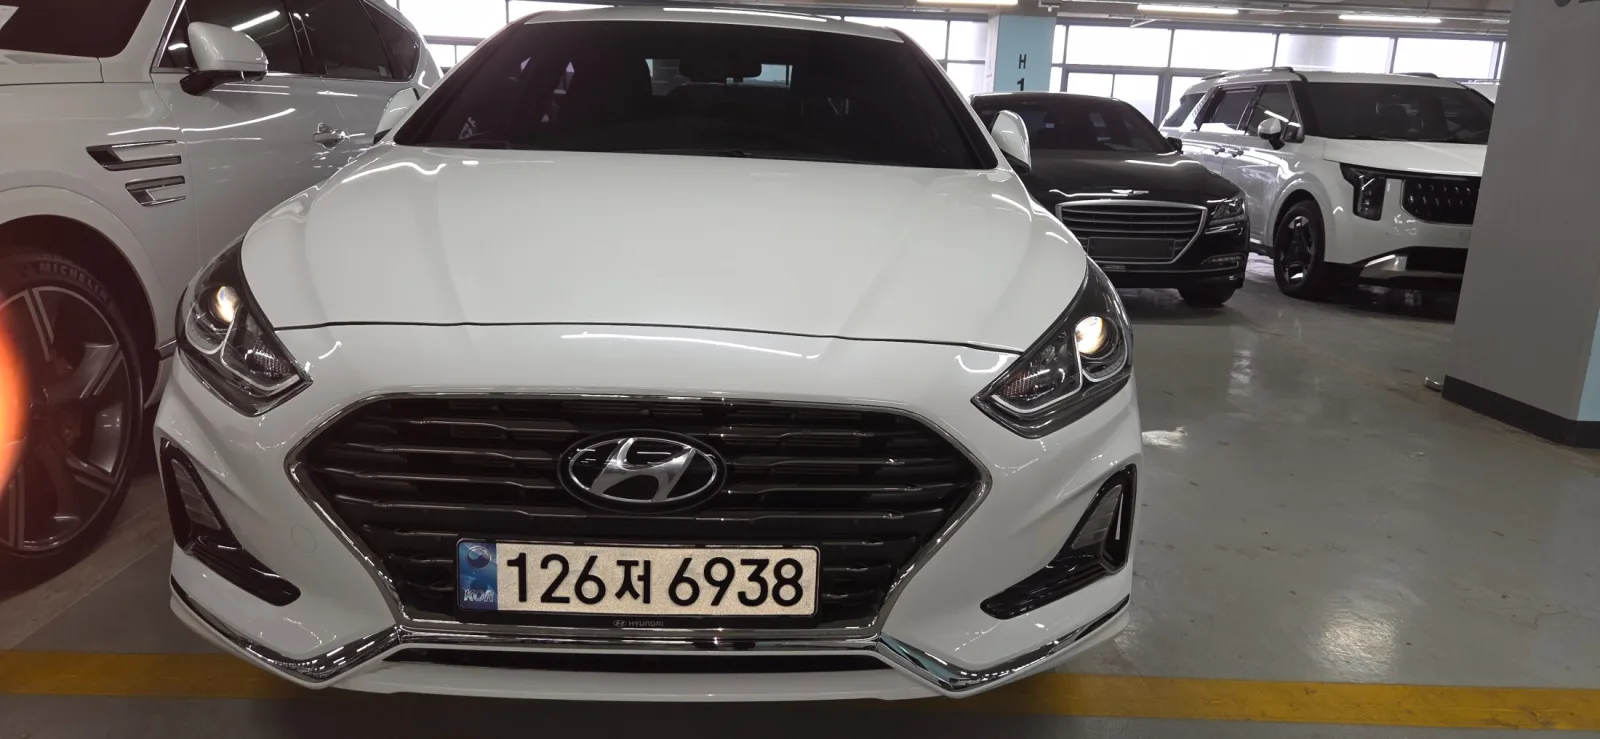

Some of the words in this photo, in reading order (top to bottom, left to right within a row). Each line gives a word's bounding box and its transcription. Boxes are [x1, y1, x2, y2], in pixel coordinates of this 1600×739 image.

[1018, 53, 1027, 69] H
[1017, 77, 1025, 91] 1
[38, 262, 108, 301] MICHELIN
[506, 552, 651, 605] 126저
[667, 556, 804, 607] 6938
[463, 588, 495, 603] KOR
